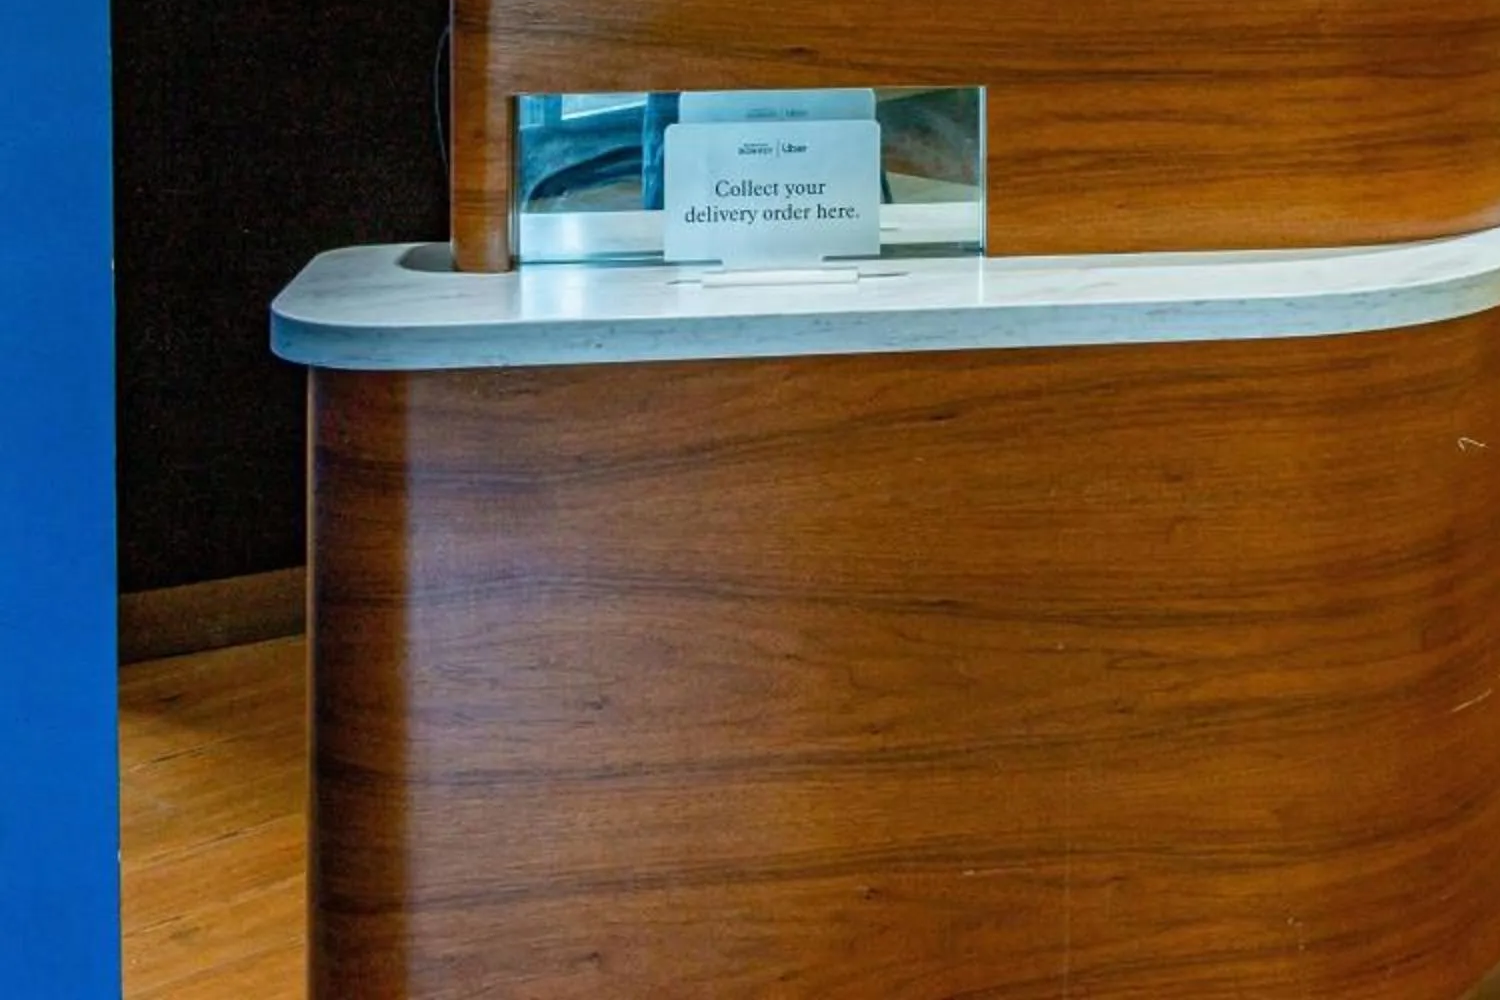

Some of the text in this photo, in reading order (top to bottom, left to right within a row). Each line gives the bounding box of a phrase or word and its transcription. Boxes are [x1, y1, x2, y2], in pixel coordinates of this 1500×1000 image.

[781, 142, 808, 153] Uber
[714, 179, 826, 199] Collect your
[684, 203, 860, 225] delivery order here.
